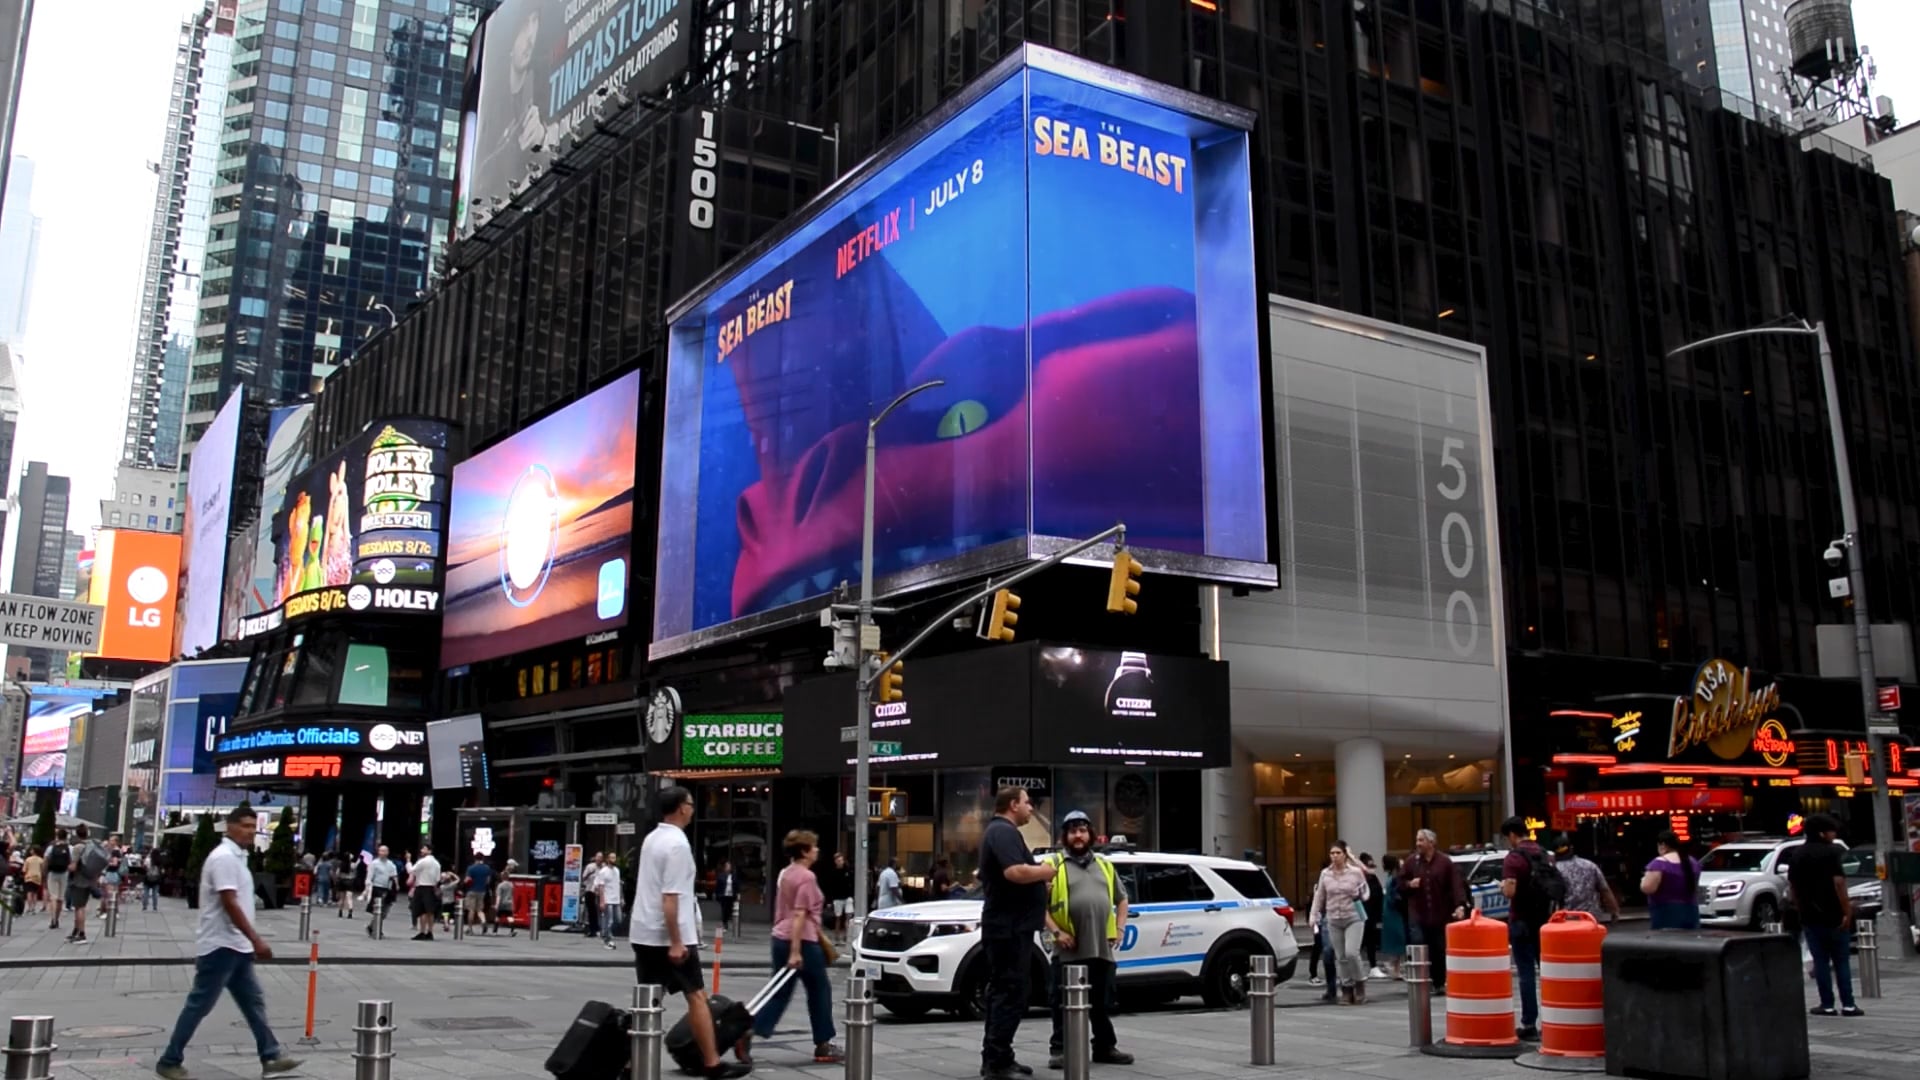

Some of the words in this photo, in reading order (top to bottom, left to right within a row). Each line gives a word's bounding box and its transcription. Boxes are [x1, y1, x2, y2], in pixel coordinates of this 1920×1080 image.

[549, 0, 679, 118] TIMCAST.CO
[624, 18, 679, 82] PLATFORMS
[1034, 115, 1091, 160] SEA
[1096, 132, 1186, 194] BEAST
[688, 110, 717, 229] 1500
[836, 206, 901, 280] NETFLIX
[924, 167, 968, 216] JULY
[971, 158, 984, 185] 8
[717, 313, 743, 364] SEA
[746, 279, 794, 337] BEAST
[405, 541, 431, 556] 8/7c
[319, 591, 346, 612] 8/7c
[374, 588, 439, 610] HOLEY
[21, 603, 58, 621] FLOW
[60, 608, 95, 626] ZONE
[128, 606, 161, 628] LG
[4, 622, 38, 639] KEEP
[42, 626, 93, 646] MOVING
[1695, 662, 1728, 702] USA
[874, 701, 907, 718] CITIZEN
[1116, 697, 1152, 709] CITIZEN
[256, 731, 295, 746] California:
[296, 727, 360, 746] Officials
[703, 741, 777, 756] COFFEE
[284, 755, 342, 777] ESPN
[997, 776, 1047, 790] CITIZEN
